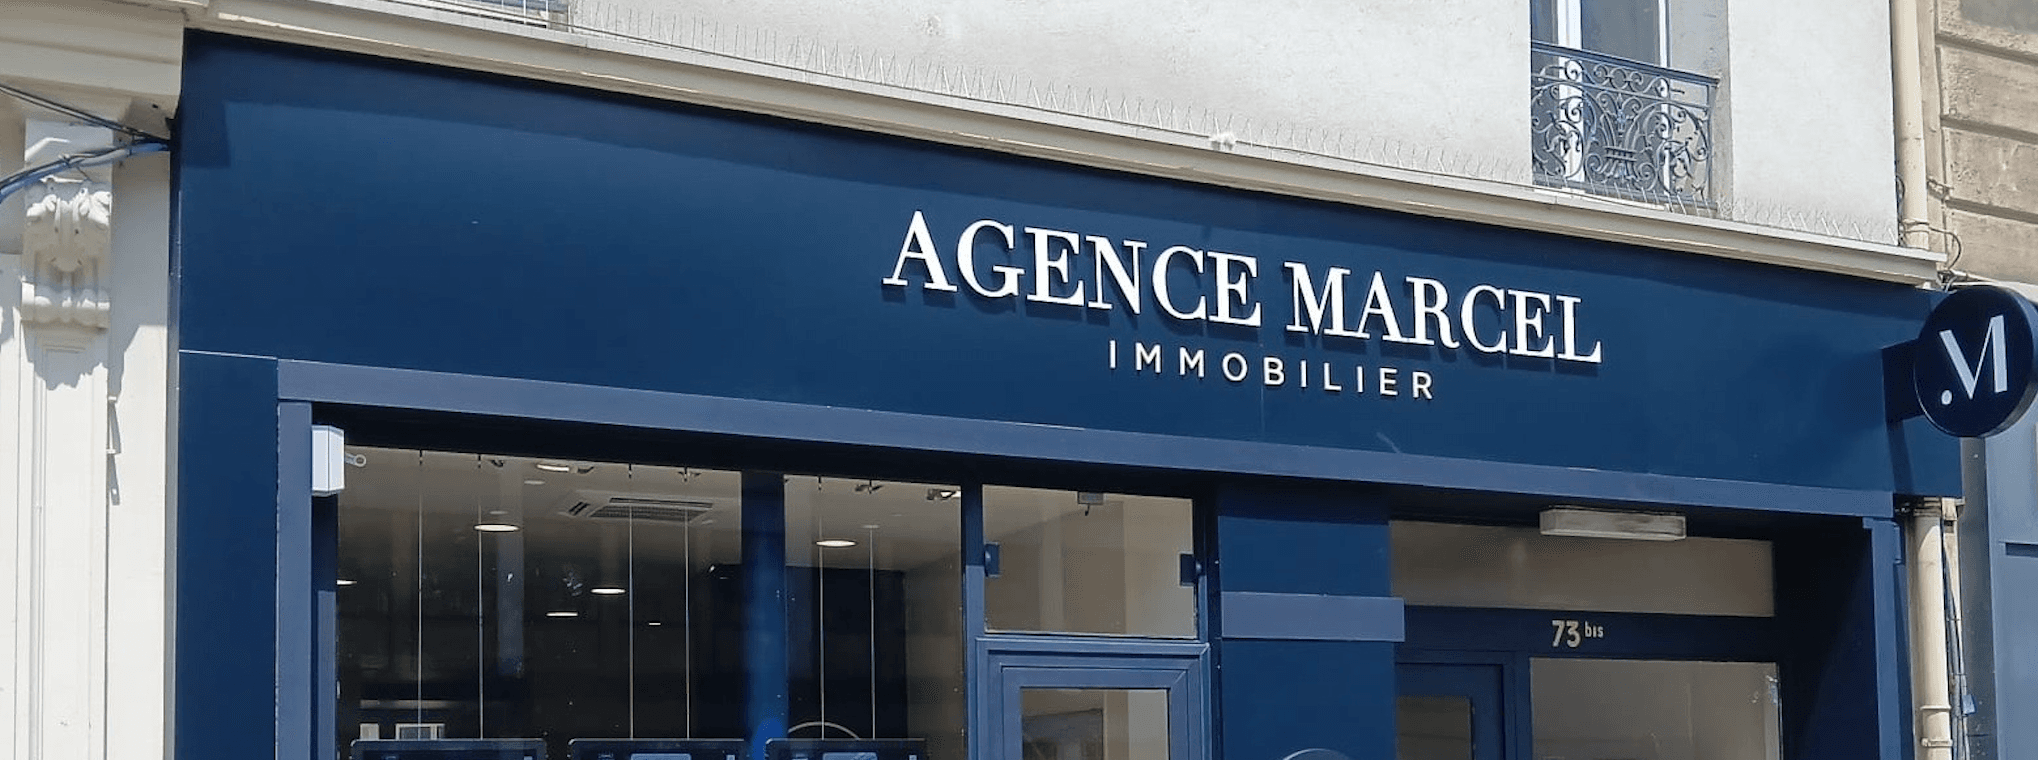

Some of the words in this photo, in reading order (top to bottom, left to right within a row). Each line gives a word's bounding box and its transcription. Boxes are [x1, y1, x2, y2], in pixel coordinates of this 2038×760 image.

[882, 209, 1262, 328] AGENCE
[1283, 260, 1603, 364] MARCEL
[1109, 339, 1434, 400] IMMOBILIER
[1551, 619, 1581, 648] 73
[1584, 620, 1604, 639] bis
